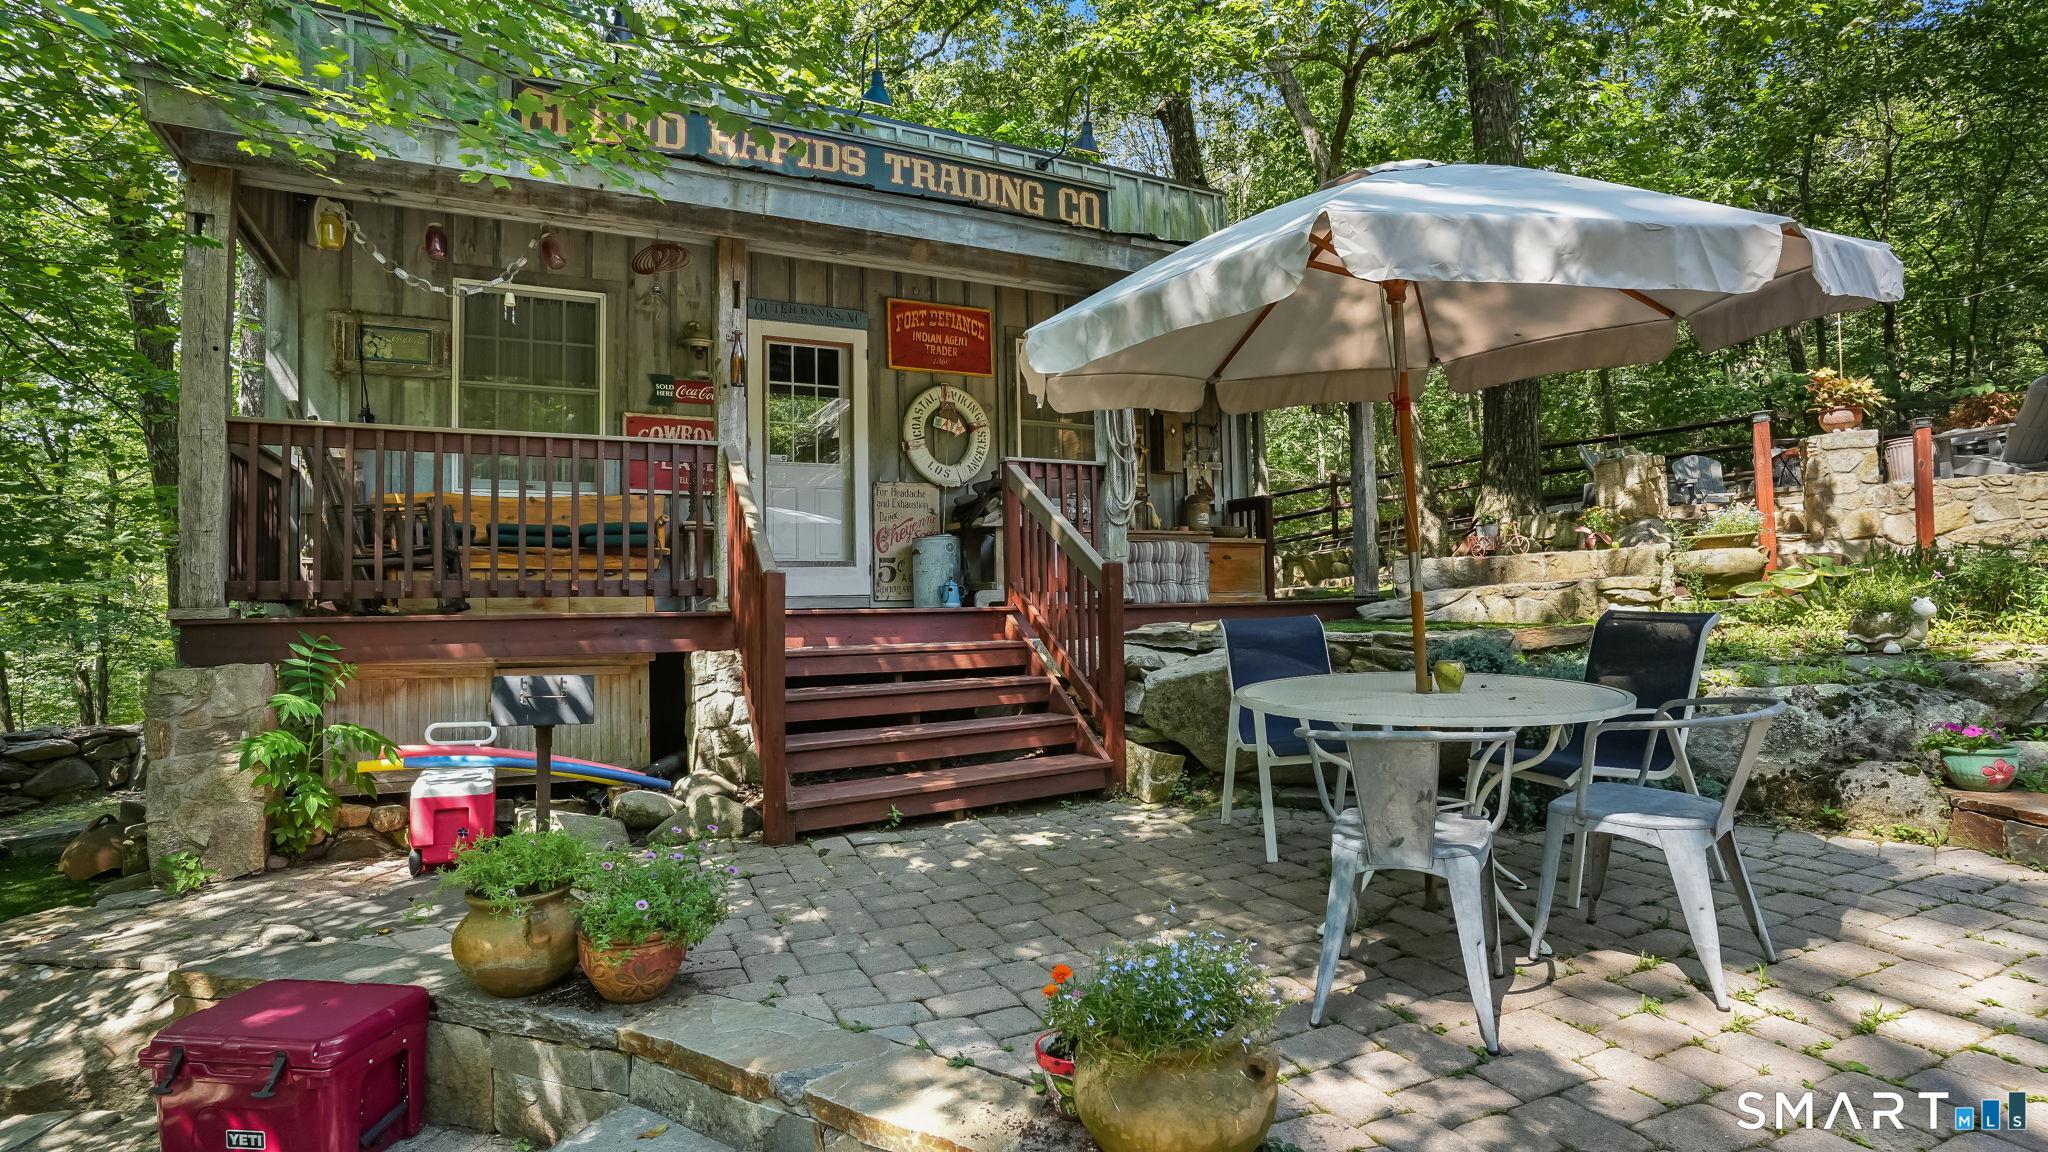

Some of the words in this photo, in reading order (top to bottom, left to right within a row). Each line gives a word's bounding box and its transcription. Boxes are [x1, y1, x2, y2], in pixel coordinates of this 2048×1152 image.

[708, 119, 866, 178] RAPIDS
[884, 152, 1045, 217] TRADING
[754, 301, 797, 316] OUTER
[896, 309, 927, 333] FORT
[929, 309, 985, 342] DEFIANCE
[912, 331, 942, 344] INDIAN
[944, 334, 968, 347] AGENT
[925, 344, 958, 357] TRADER
[655, 383, 675, 391] SOLD
[911, 392, 938, 439] COASTAL
[927, 460, 951, 478] LOS
[967, 430, 987, 475] ANGELES
[876, 488, 888, 497] For
[891, 488, 926, 498] Headache
[876, 498, 890, 508] and
[892, 499, 929, 510] Exhaustion
[875, 514, 938, 554] Cheyenne
[228, 1133, 263, 1147] YETI
